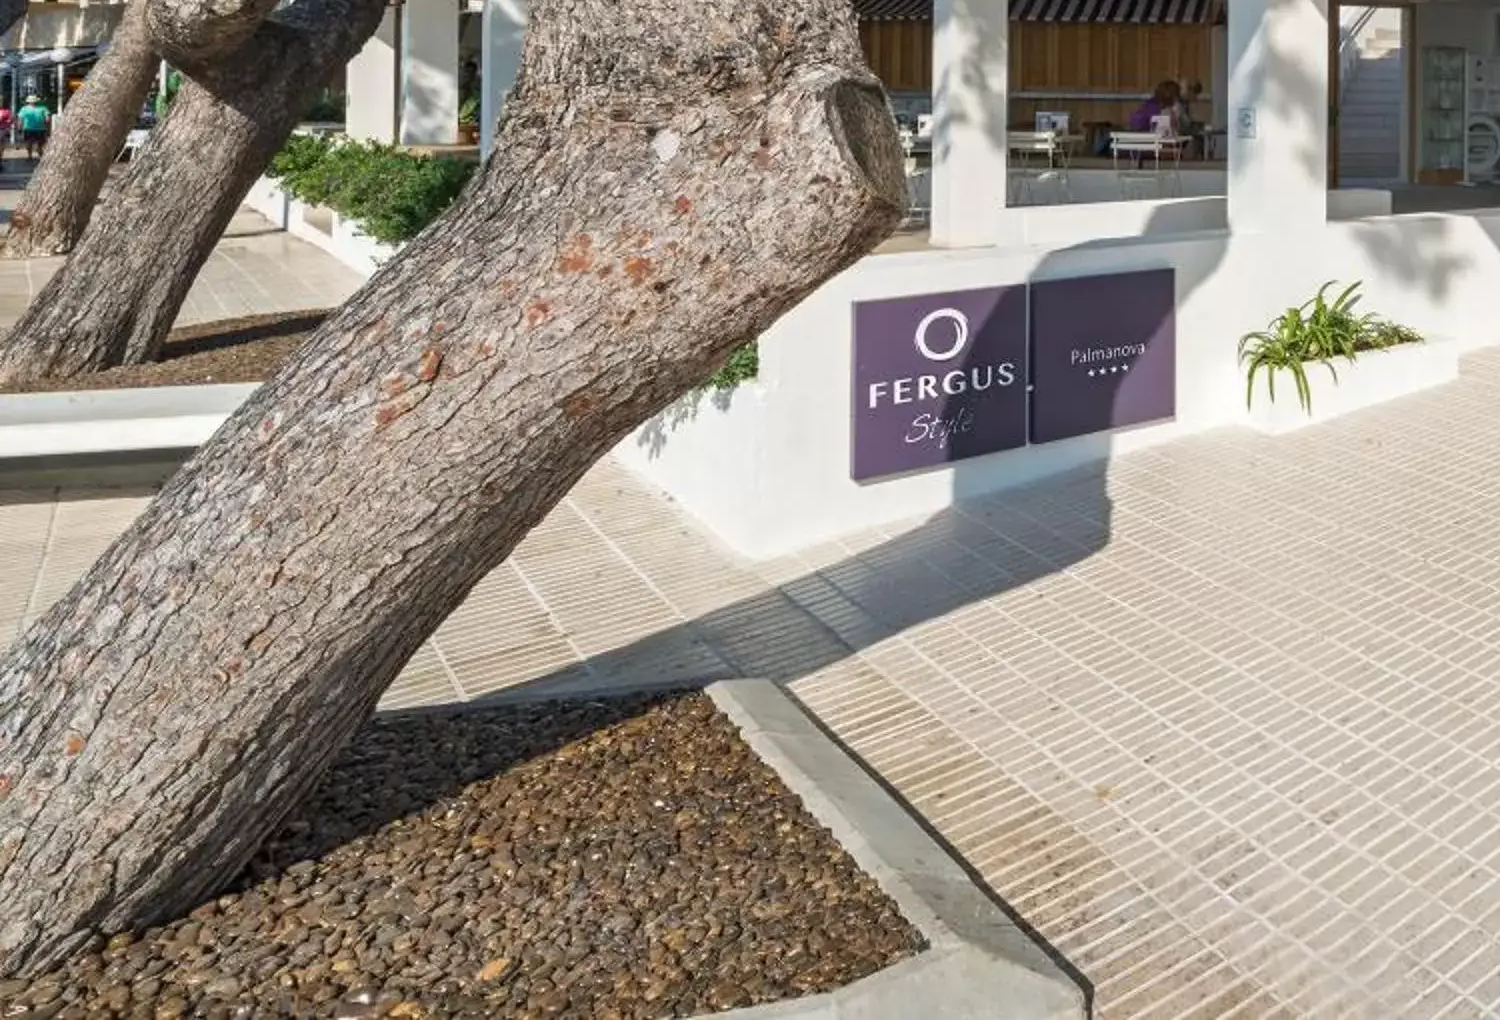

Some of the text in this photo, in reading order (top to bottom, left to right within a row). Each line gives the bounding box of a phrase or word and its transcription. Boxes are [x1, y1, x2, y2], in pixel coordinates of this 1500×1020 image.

[1071, 342, 1145, 365] Palmanova
[869, 362, 1014, 409] FERGUS
[905, 407, 974, 449] Style
